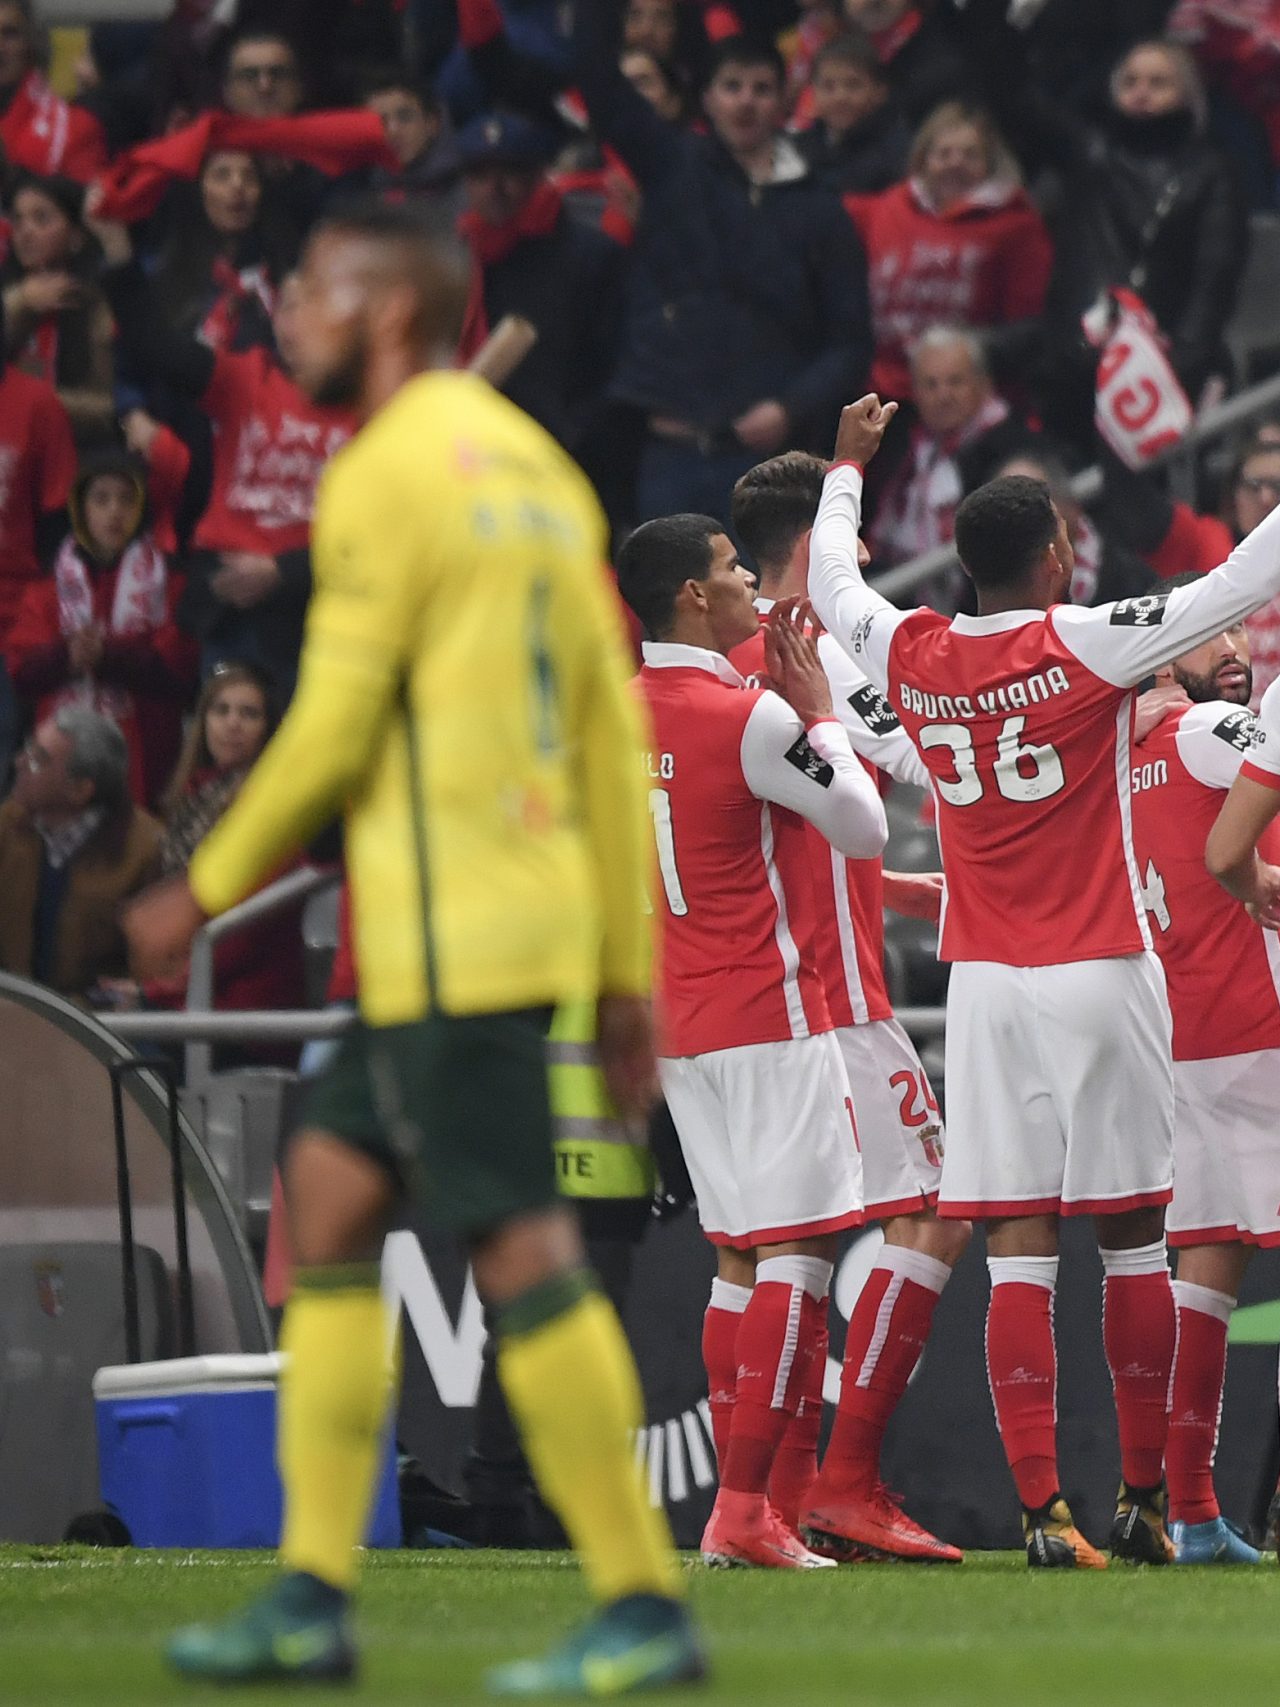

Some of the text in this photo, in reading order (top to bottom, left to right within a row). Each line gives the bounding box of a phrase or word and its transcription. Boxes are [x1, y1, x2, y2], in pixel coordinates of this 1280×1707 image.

[899, 665, 1070, 719] BRUNO VIANA
[918, 714, 1066, 807] 36
